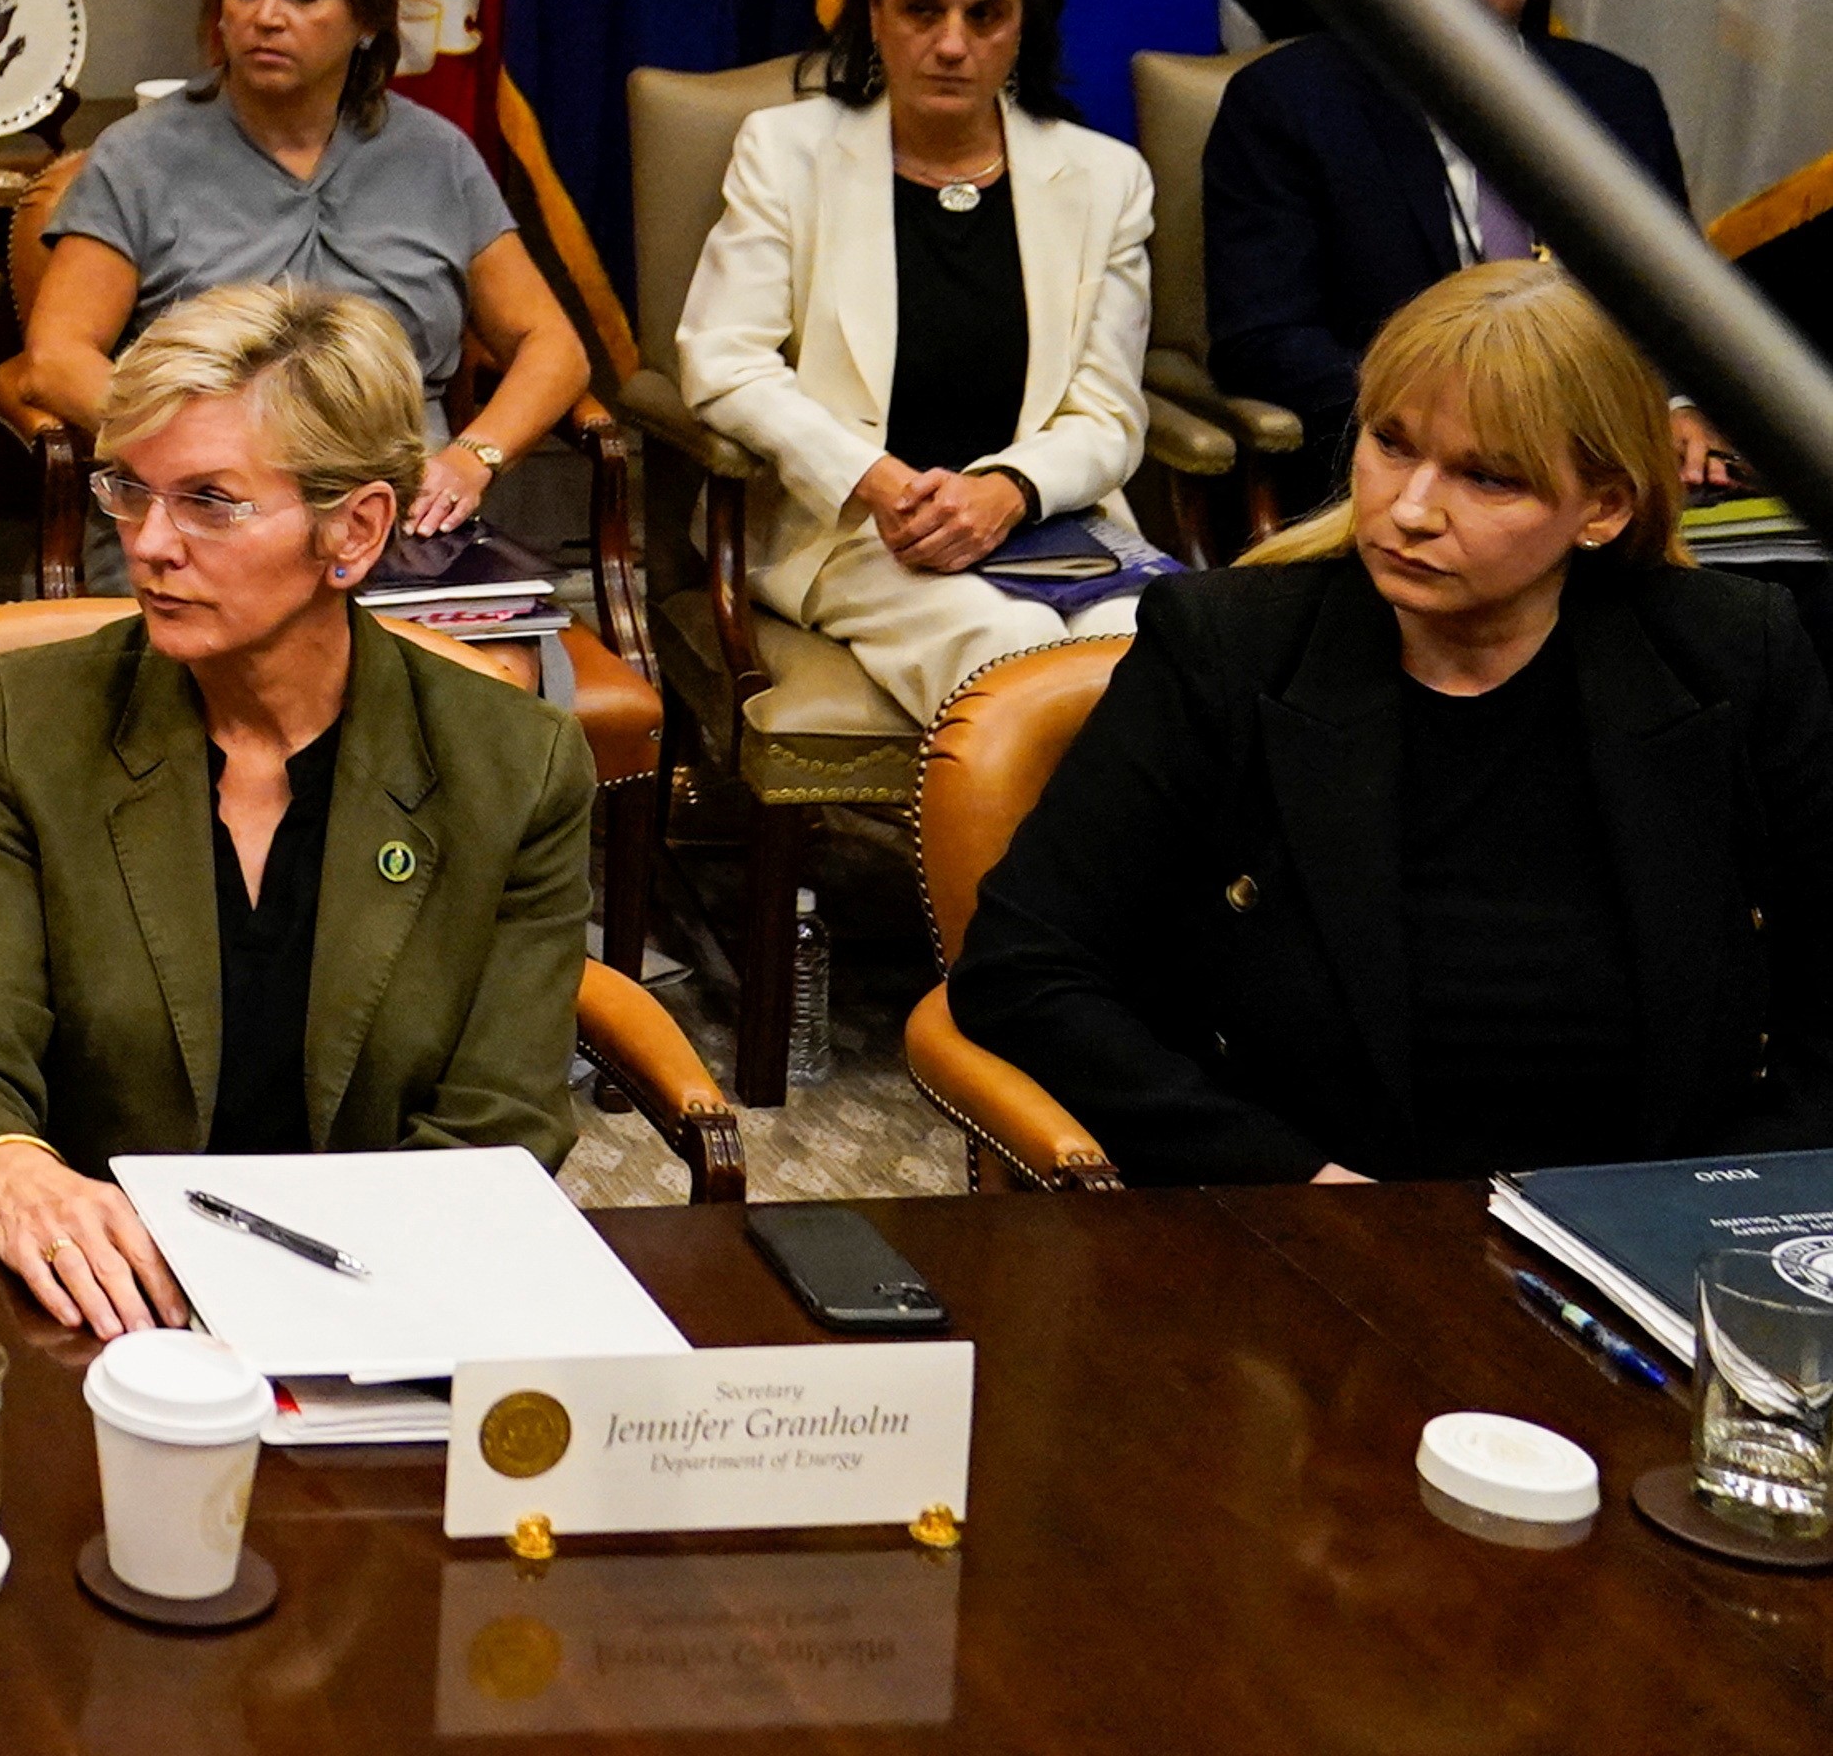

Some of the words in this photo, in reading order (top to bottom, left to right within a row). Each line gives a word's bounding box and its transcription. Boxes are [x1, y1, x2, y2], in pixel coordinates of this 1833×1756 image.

[715, 1381, 805, 1402] Secretary
[603, 1408, 735, 1451] Jennifer
[745, 1404, 910, 1440] Granholm
[649, 1451, 764, 1476] Department
[769, 1449, 789, 1471] of
[794, 1449, 865, 1473] Energy
